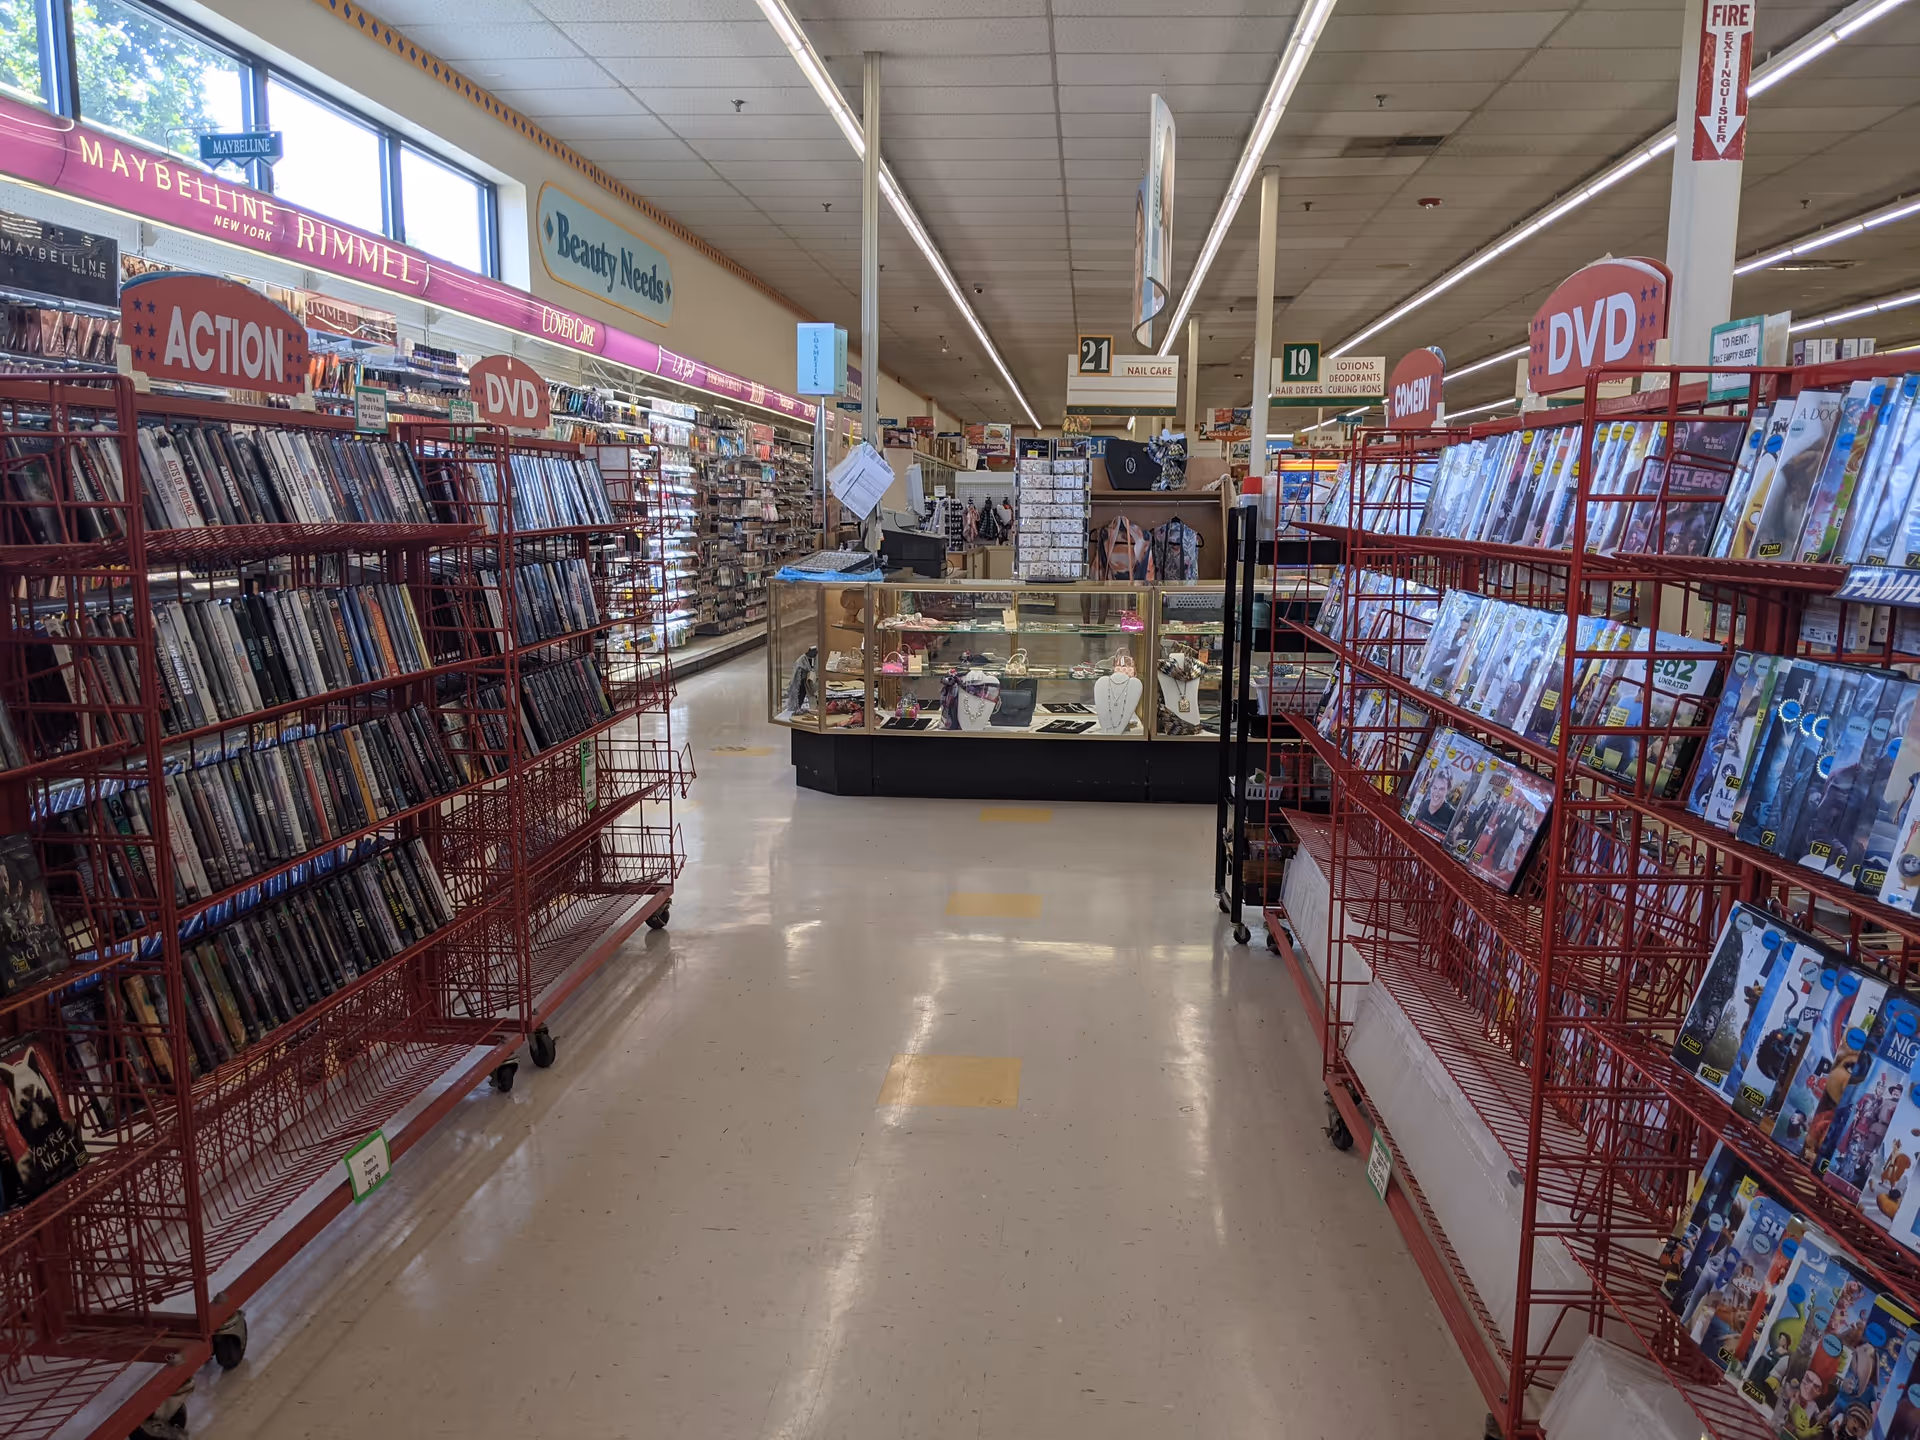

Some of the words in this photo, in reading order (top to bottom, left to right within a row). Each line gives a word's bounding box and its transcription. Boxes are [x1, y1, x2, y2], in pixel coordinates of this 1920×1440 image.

[1711, 4, 1750, 27] FIRE
[1716, 31, 1735, 144] EXTINGUISHER
[211, 137, 271, 154] MAYBELLINE
[79, 134, 276, 226] MAYBELLINE
[213, 214, 240, 232] NEW
[242, 222, 273, 243] YORK
[1, 238, 107, 273] MAYBELLINE
[297, 214, 420, 286] RIMMEL
[556, 210, 617, 293] Beauty
[620, 247, 664, 304] Needs
[71, 266, 87, 277] NEW
[88, 269, 107, 279] YORK
[163, 305, 284, 383] ACTION
[1547, 291, 1637, 375] DVD
[1722, 337, 1731, 349] TO
[1732, 333, 1751, 347] RENT:
[1081, 339, 1110, 371] 21
[1287, 348, 1311, 376] 19
[1336, 361, 1375, 371] LOTIONS
[1712, 355, 1723, 364] TAKE
[1723, 351, 1739, 362] EMPTY
[1738, 347, 1757, 360] SLEEVE
[1127, 366, 1148, 376] NAIL
[1150, 366, 1173, 376] CARE
[1329, 373, 1381, 383] DEODORANTS
[484, 376, 539, 420] DVD
[1275, 386, 1294, 395] HAIR
[1296, 385, 1323, 395] DRYERS
[1328, 384, 1357, 395] CURLING
[1359, 384, 1381, 394] IRONS
[1394, 374, 1433, 419] COMEDY
[1798, 408, 1806, 419] A
[166, 458, 180, 477] ACTS
[183, 453, 192, 466] AD
[191, 471, 207, 504] ASTRA
[1647, 466, 1726, 490] HUSTLERS
[174, 476, 184, 486] OF
[288, 454, 300, 478] ANGEL
[302, 491, 316, 518] FALLEN
[178, 485, 196, 518] VIOLENCE
[334, 618, 343, 631] THE
[310, 628, 324, 651] GOTTI
[337, 631, 349, 651] GREAT
[155, 646, 179, 696] EXPENDABLES
[344, 651, 354, 667] WALL
[1658, 677, 1689, 691] UNRATED
[408, 730, 427, 766] PRIMAL
[318, 781, 328, 796] THE
[321, 796, 335, 820] BRAVE
[214, 815, 227, 838] MAZE
[222, 838, 239, 873] RUNNER
[129, 854, 146, 878] WICK
[334, 898, 362, 951] UNDERWATER
[1886, 1050, 1915, 1069] BATTL
[29, 1127, 64, 1166] YOU'RE
[40, 1137, 79, 1172] NEXT
